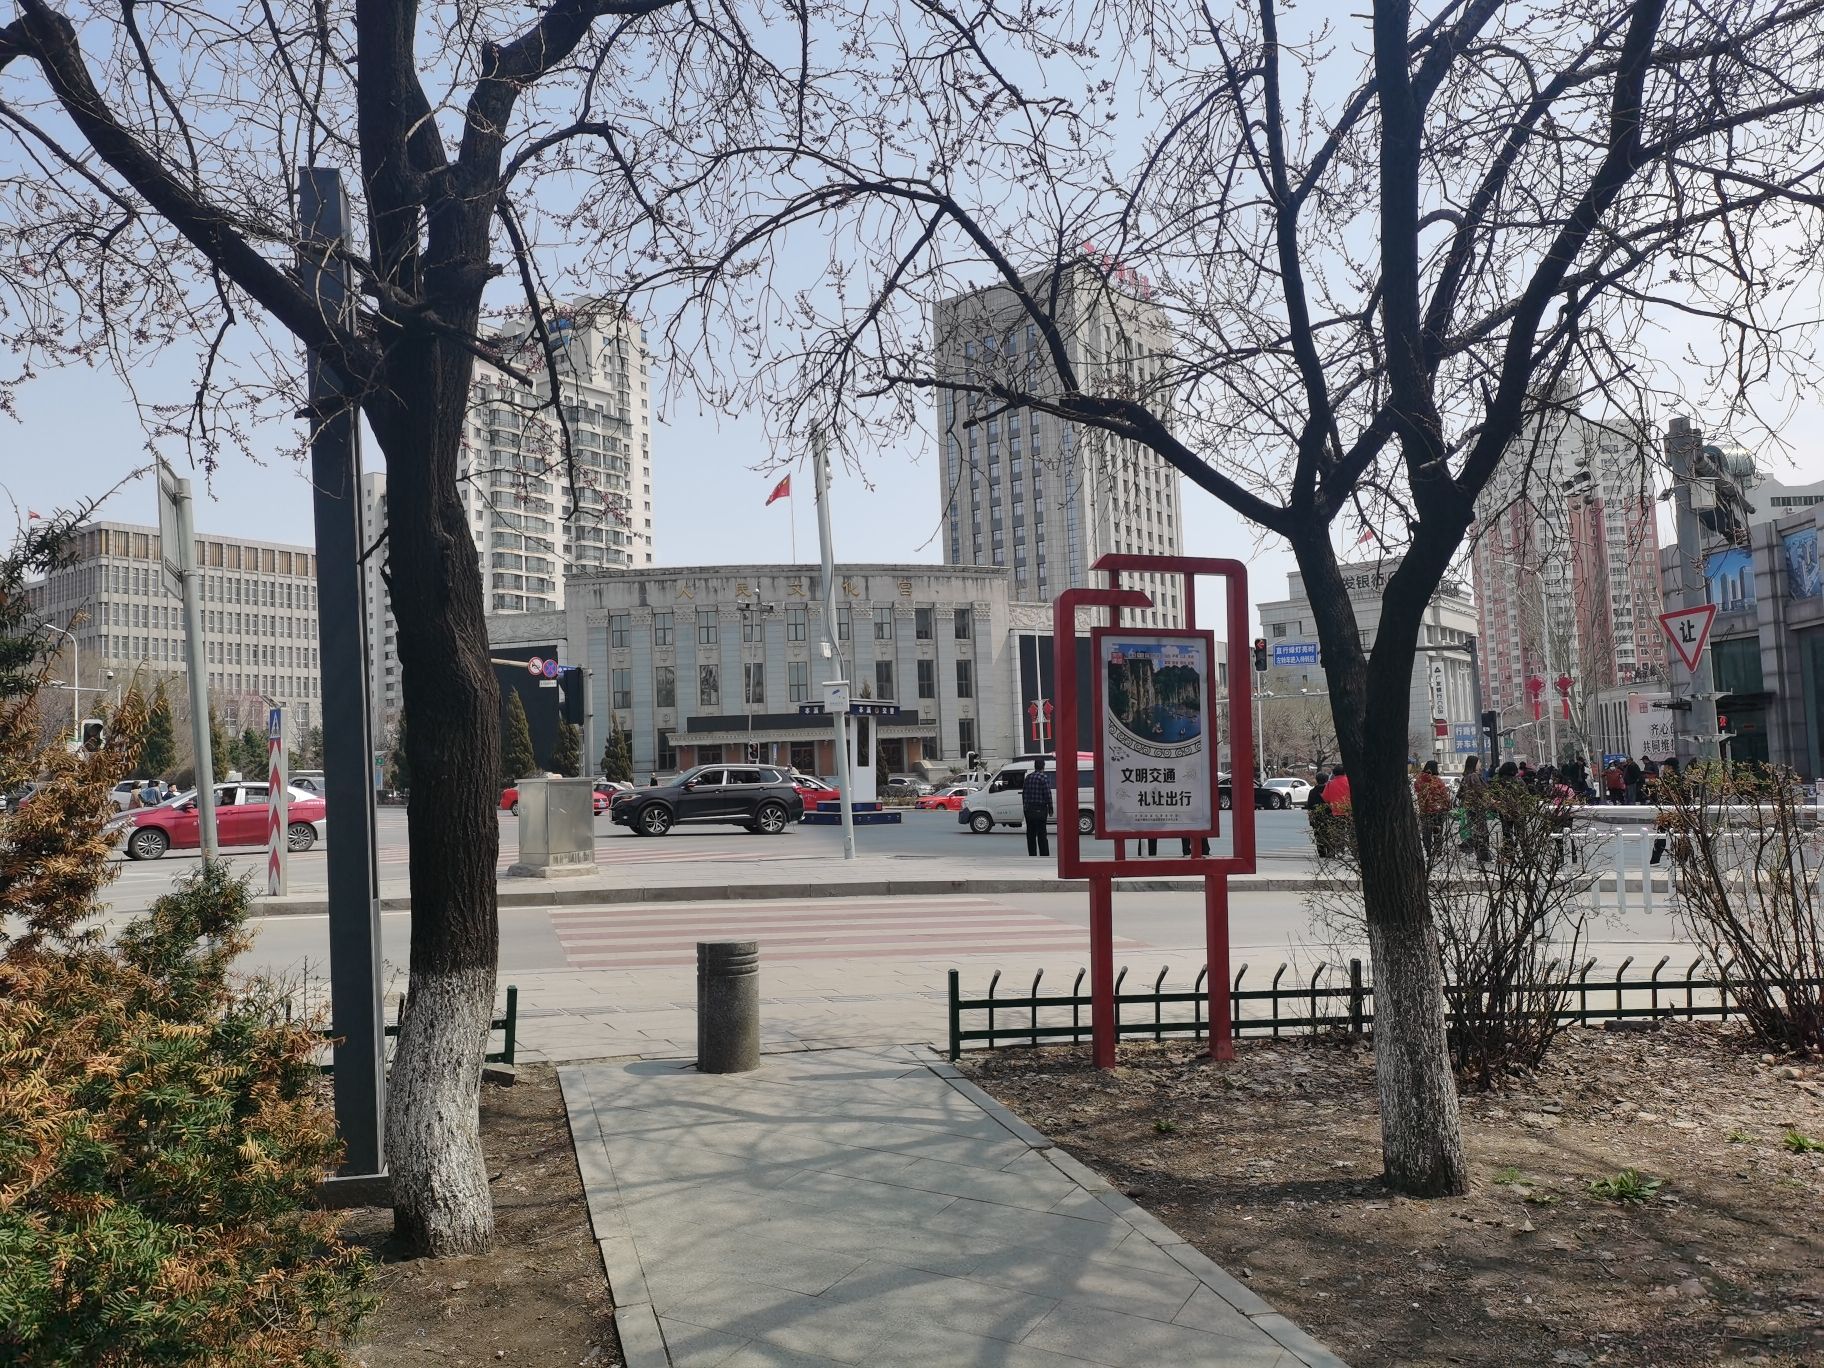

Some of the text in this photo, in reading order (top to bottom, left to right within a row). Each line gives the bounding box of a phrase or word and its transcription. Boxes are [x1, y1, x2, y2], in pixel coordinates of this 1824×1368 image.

[676, 580, 912, 599] 人民文化宫
[1679, 620, 1696, 643] 让
[1276, 645, 1315, 655] 直行绿灯亮时
[1121, 768, 1176, 784] 文明交通
[1137, 790, 1192, 807] 礼让出行
